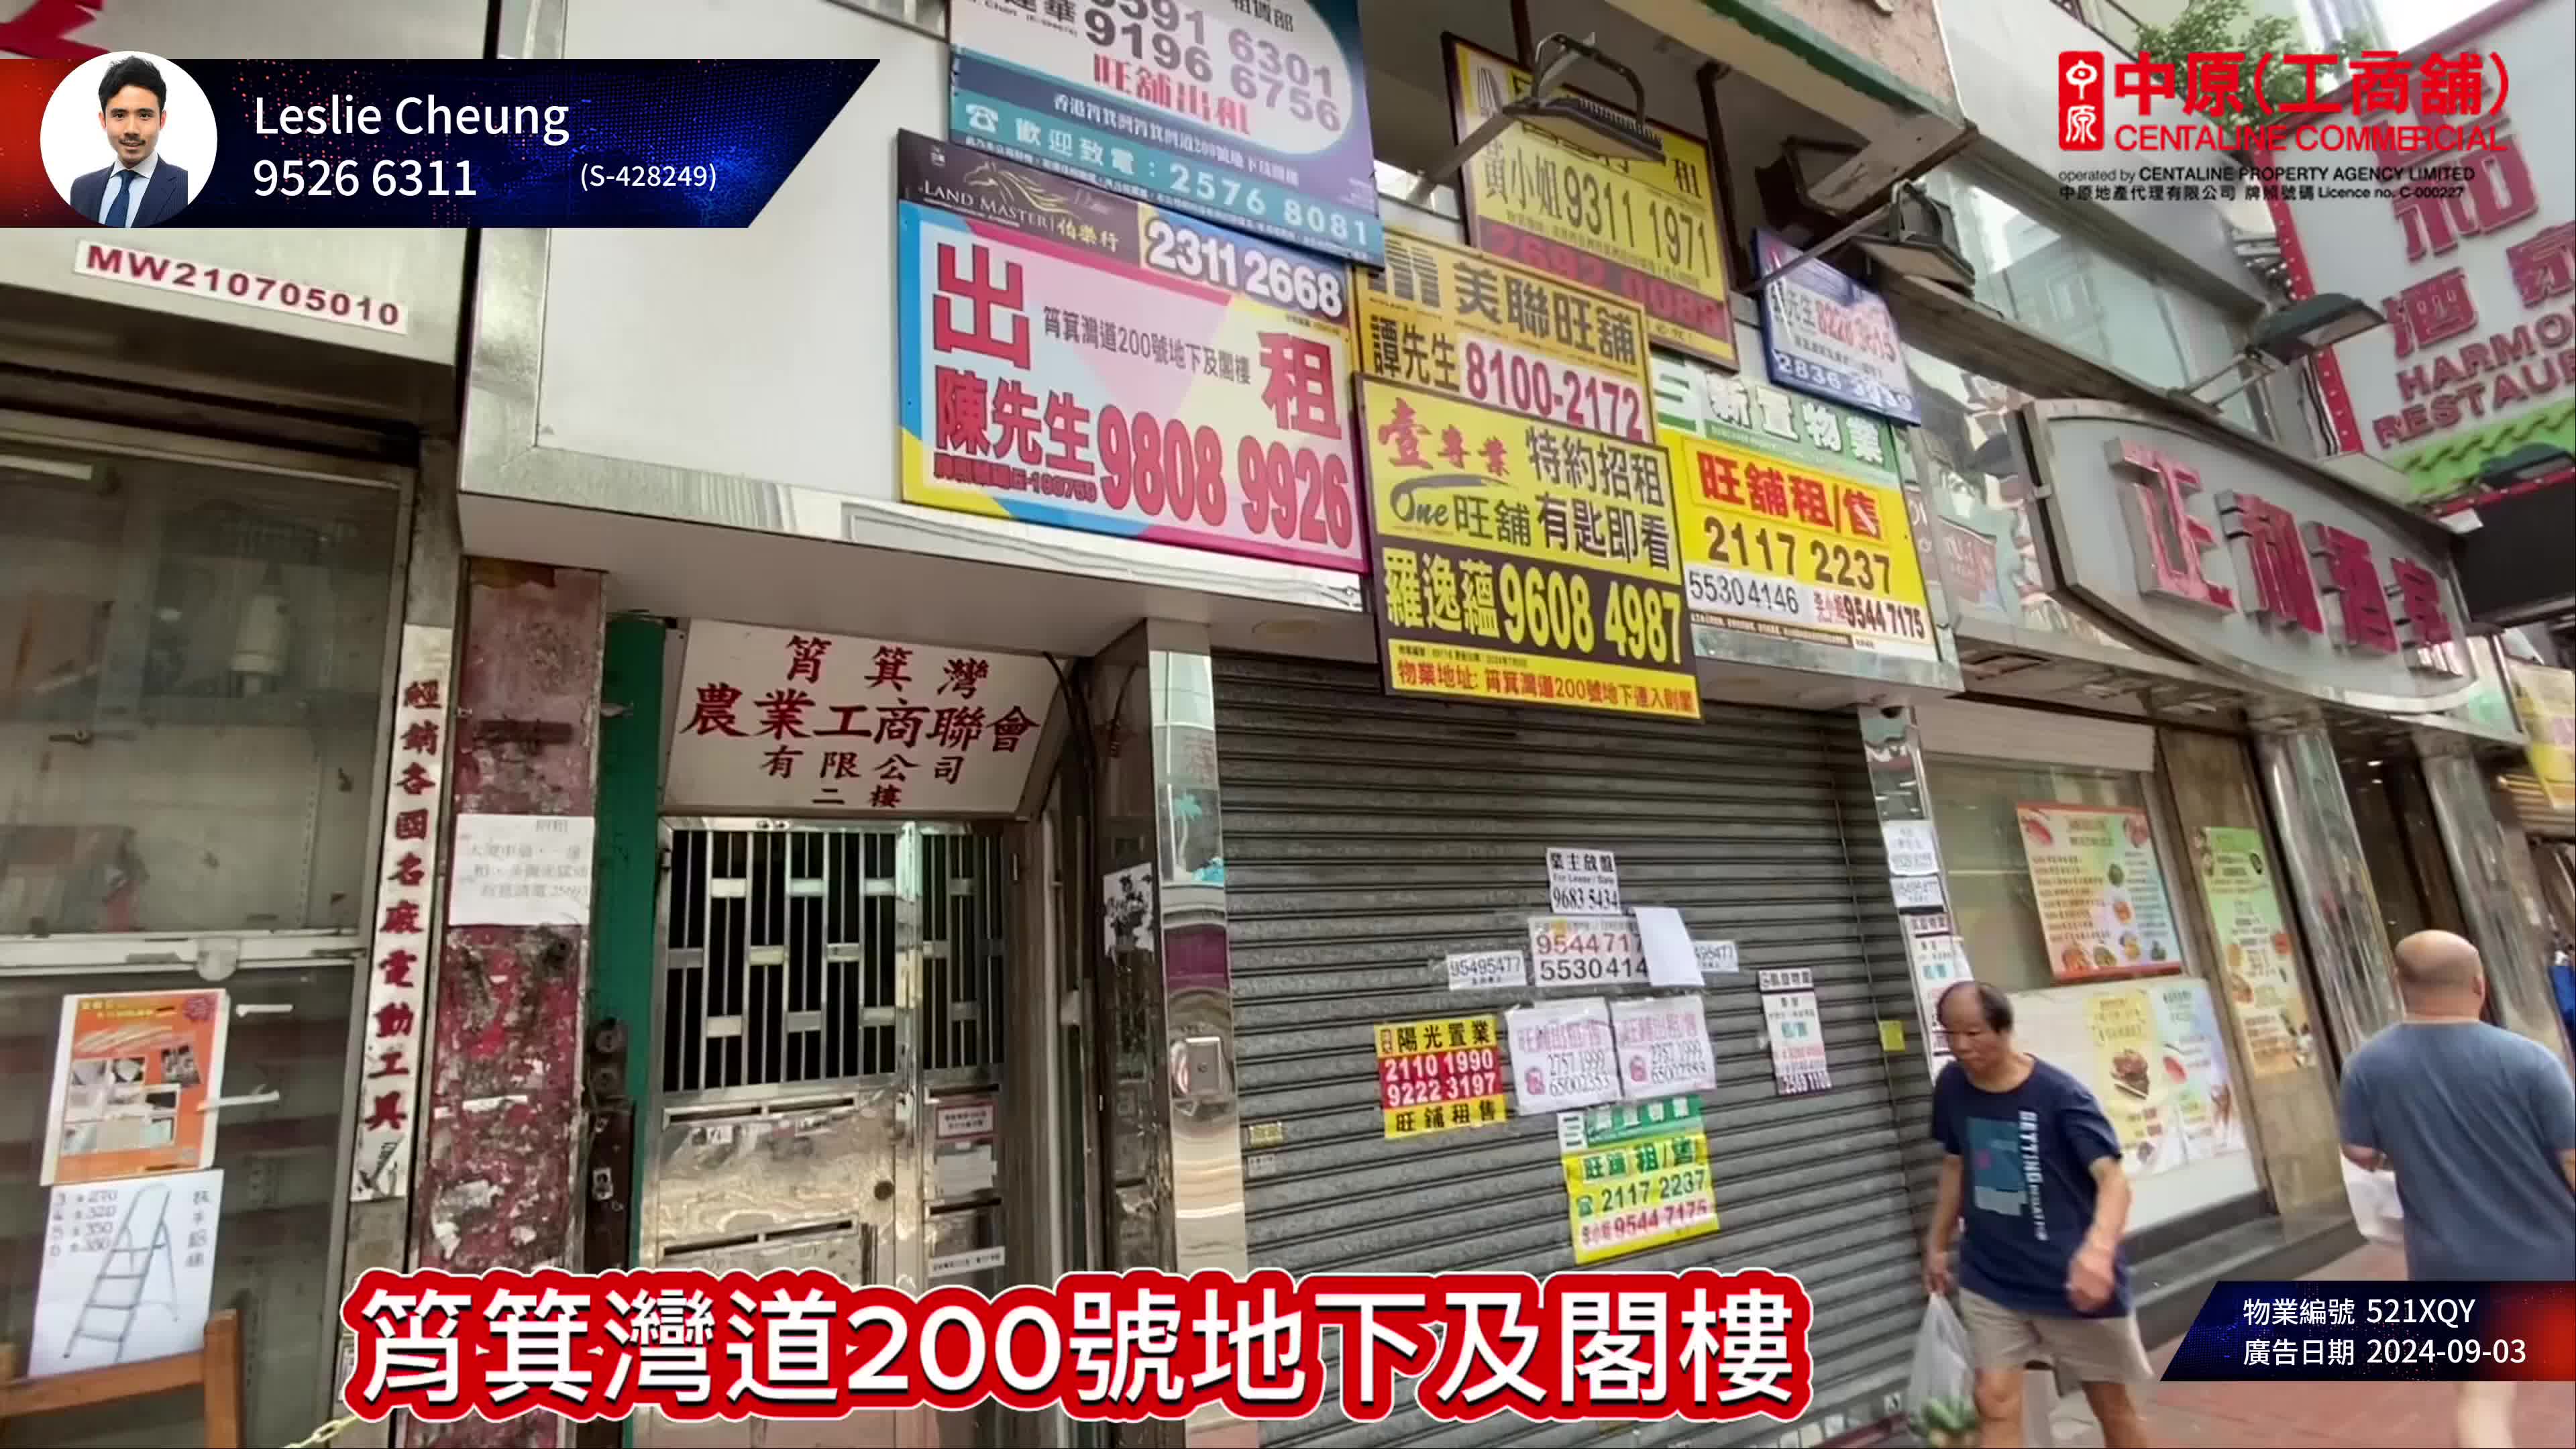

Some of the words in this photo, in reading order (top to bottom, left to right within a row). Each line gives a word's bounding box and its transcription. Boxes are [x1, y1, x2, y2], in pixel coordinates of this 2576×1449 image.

[1085, 8, 1212, 82] 9196
[1230, 64, 1340, 131] 6756
[1228, 28, 1332, 97] 6301
[924, 180, 973, 205] LAND
[980, 198, 1049, 228] MASTER
[1171, 165, 1266, 215] 2576
[1285, 199, 1366, 245] 8081
[1564, 166, 1634, 248] 9311
[1650, 201, 1711, 278] 1971
[87, 244, 400, 327] MW210705010
[1147, 220, 1238, 287] 2311
[1244, 250, 1342, 317] 2668
[932, 242, 1031, 371] 出
[1454, 262, 1637, 366] 美聯旺舖
[1257, 332, 1342, 440] 租
[1371, 314, 1460, 393] 譚先生
[1466, 341, 1643, 441] 8100-2172
[2396, 305, 2575, 400] HARMO
[934, 364, 1095, 476] 陳先生
[1097, 405, 1228, 527] 9808
[1238, 435, 1352, 549] 9926
[1525, 425, 1664, 508] 特約招租
[1534, 490, 1670, 572] 有匙即看
[1705, 516, 1795, 576] 2117
[1811, 540, 1890, 594] 2237
[1499, 563, 1595, 653] 9608
[1605, 580, 1682, 665] 4987
[1888, 604, 1926, 639] 7175
[786, 635, 989, 700] 筲箕灣
[679, 682, 1040, 752] 農業工商聯會
[762, 745, 965, 784] 有限公司
[812, 784, 902, 808] 二樓
[1554, 887, 1584, 908] 9683
[1450, 956, 1521, 977] 95495477
[1541, 959, 1602, 980] 5530
[1606, 957, 1648, 977] 414
[1604, 933, 1643, 953] 717
[1385, 1054, 1438, 1081] 2110
[1443, 1049, 1493, 1074] 1990
[1397, 1020, 1489, 1052] 陽光置業
[1387, 1079, 1442, 1106] 9222
[1446, 1072, 1496, 1099] 3197
[1602, 1181, 1650, 1212] 2117
[1659, 1169, 1705, 1199] 2237
[1615, 1210, 1659, 1235] 9544
